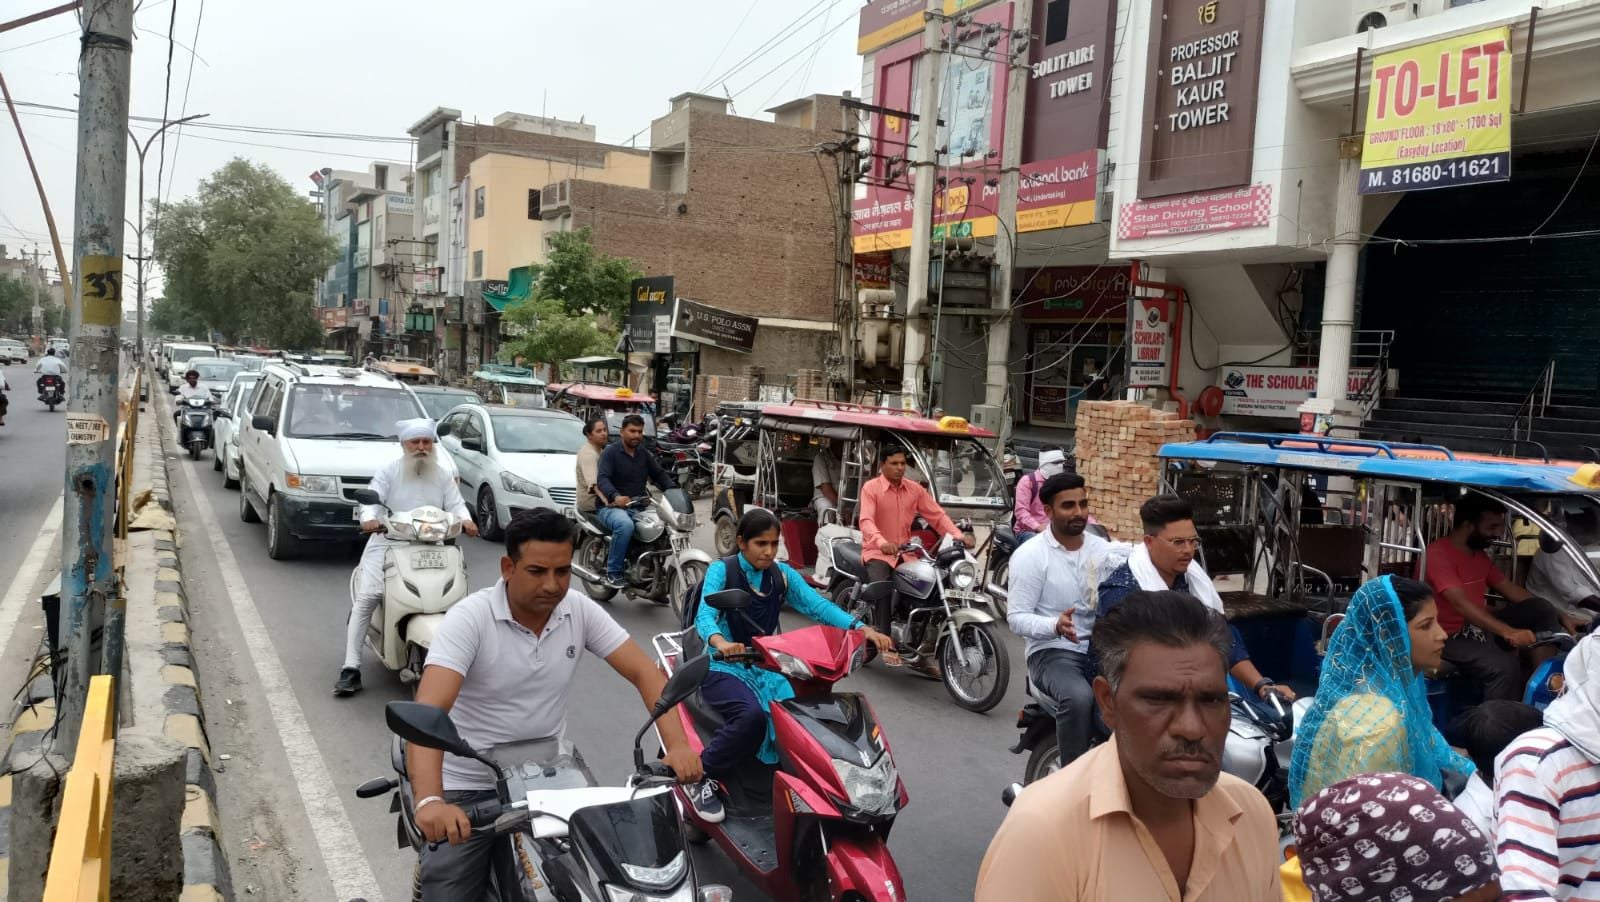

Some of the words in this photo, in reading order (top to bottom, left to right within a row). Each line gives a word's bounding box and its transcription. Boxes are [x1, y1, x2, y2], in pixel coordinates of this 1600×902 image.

[1170, 30, 1240, 63] PROFESSOR
[1032, 44, 1095, 79] SOLITAIRE
[1171, 52, 1236, 85] BALJIT
[1049, 71, 1093, 99] TOWER
[1176, 79, 1224, 107] KAUR
[1375, 40, 1505, 120] TO-LET
[1169, 103, 1229, 132] TOWER
[1369, 128, 1399, 145] GROUND
[1400, 125, 1425, 141] FLOOR
[1466, 115, 1487, 129] 1700
[1396, 143, 1430, 160] (Easyday
[1431, 138, 1466, 155] Location)
[1020, 166, 1060, 189] ational
[1061, 161, 1089, 182] bank
[1368, 171, 1387, 187] M.
[1392, 157, 1500, 185] 81680-11621
[1133, 211, 1159, 224] Star
[1162, 207, 1206, 221] Driving
[1209, 200, 1253, 214] School
[711, 315, 731, 328] POLO
[1137, 347, 1161, 361] LIBRARY
[1246, 374, 1264, 389] THE
